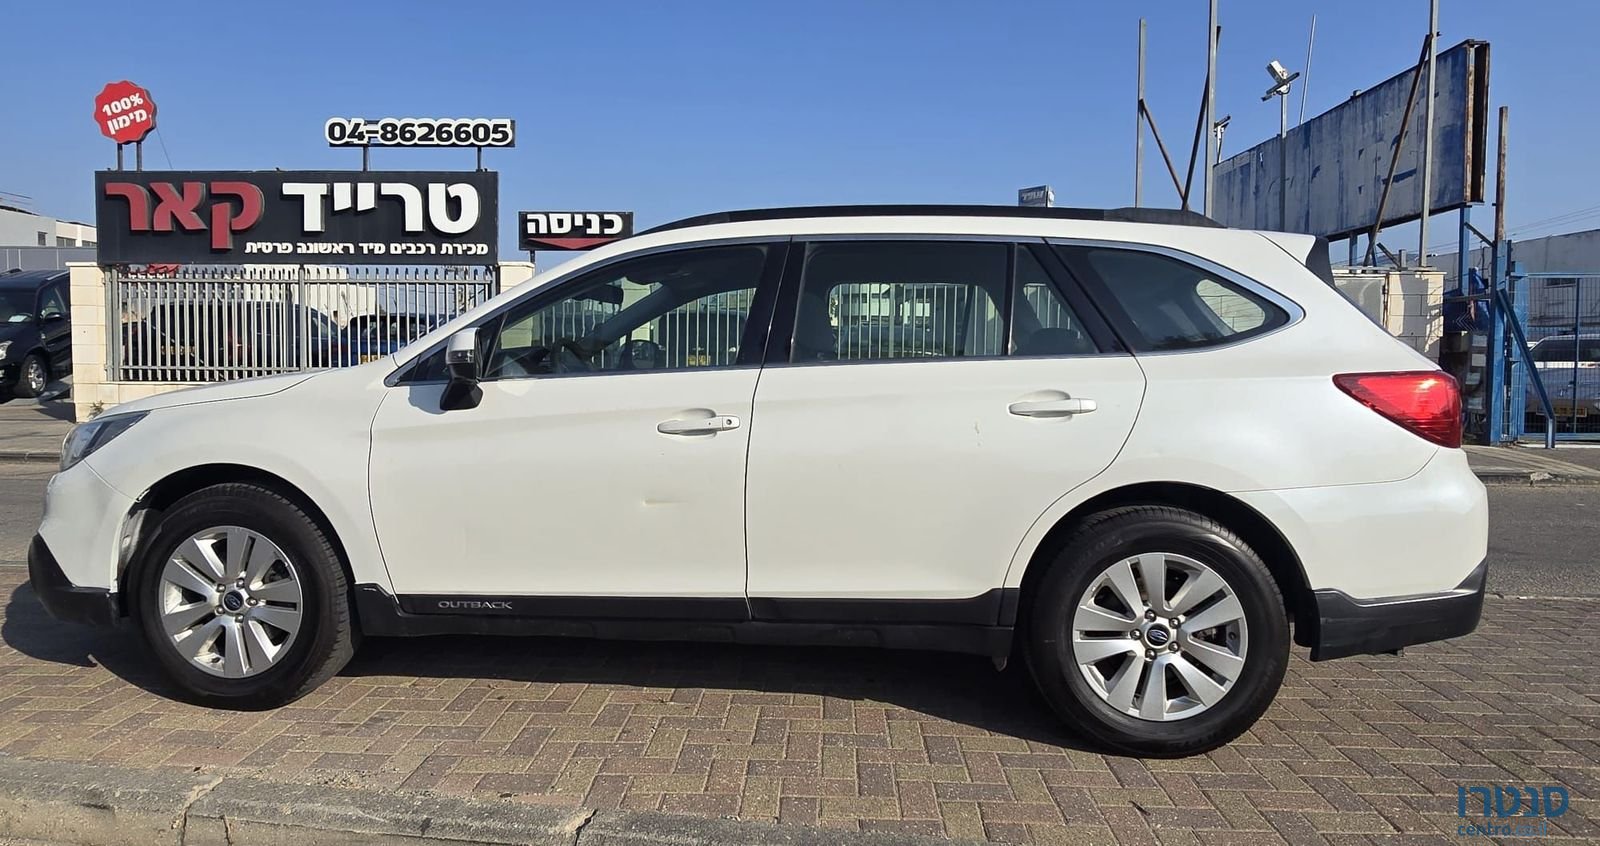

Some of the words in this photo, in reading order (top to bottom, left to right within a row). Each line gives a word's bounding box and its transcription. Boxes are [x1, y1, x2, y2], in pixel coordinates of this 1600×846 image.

[102, 92, 144, 117] 100%
[106, 107, 148, 135] מימון
[326, 119, 512, 145] 04-8626605
[105, 182, 265, 250] קאר
[281, 182, 481, 235] טרייד
[526, 213, 623, 236] כניסה
[244, 241, 294, 254] פרסית
[296, 242, 355, 255] ראשונה
[358, 242, 386, 255] מיד
[389, 242, 436, 255] רכבים
[440, 242, 489, 255] מכירת
[437, 600, 513, 610] OUTBACK
